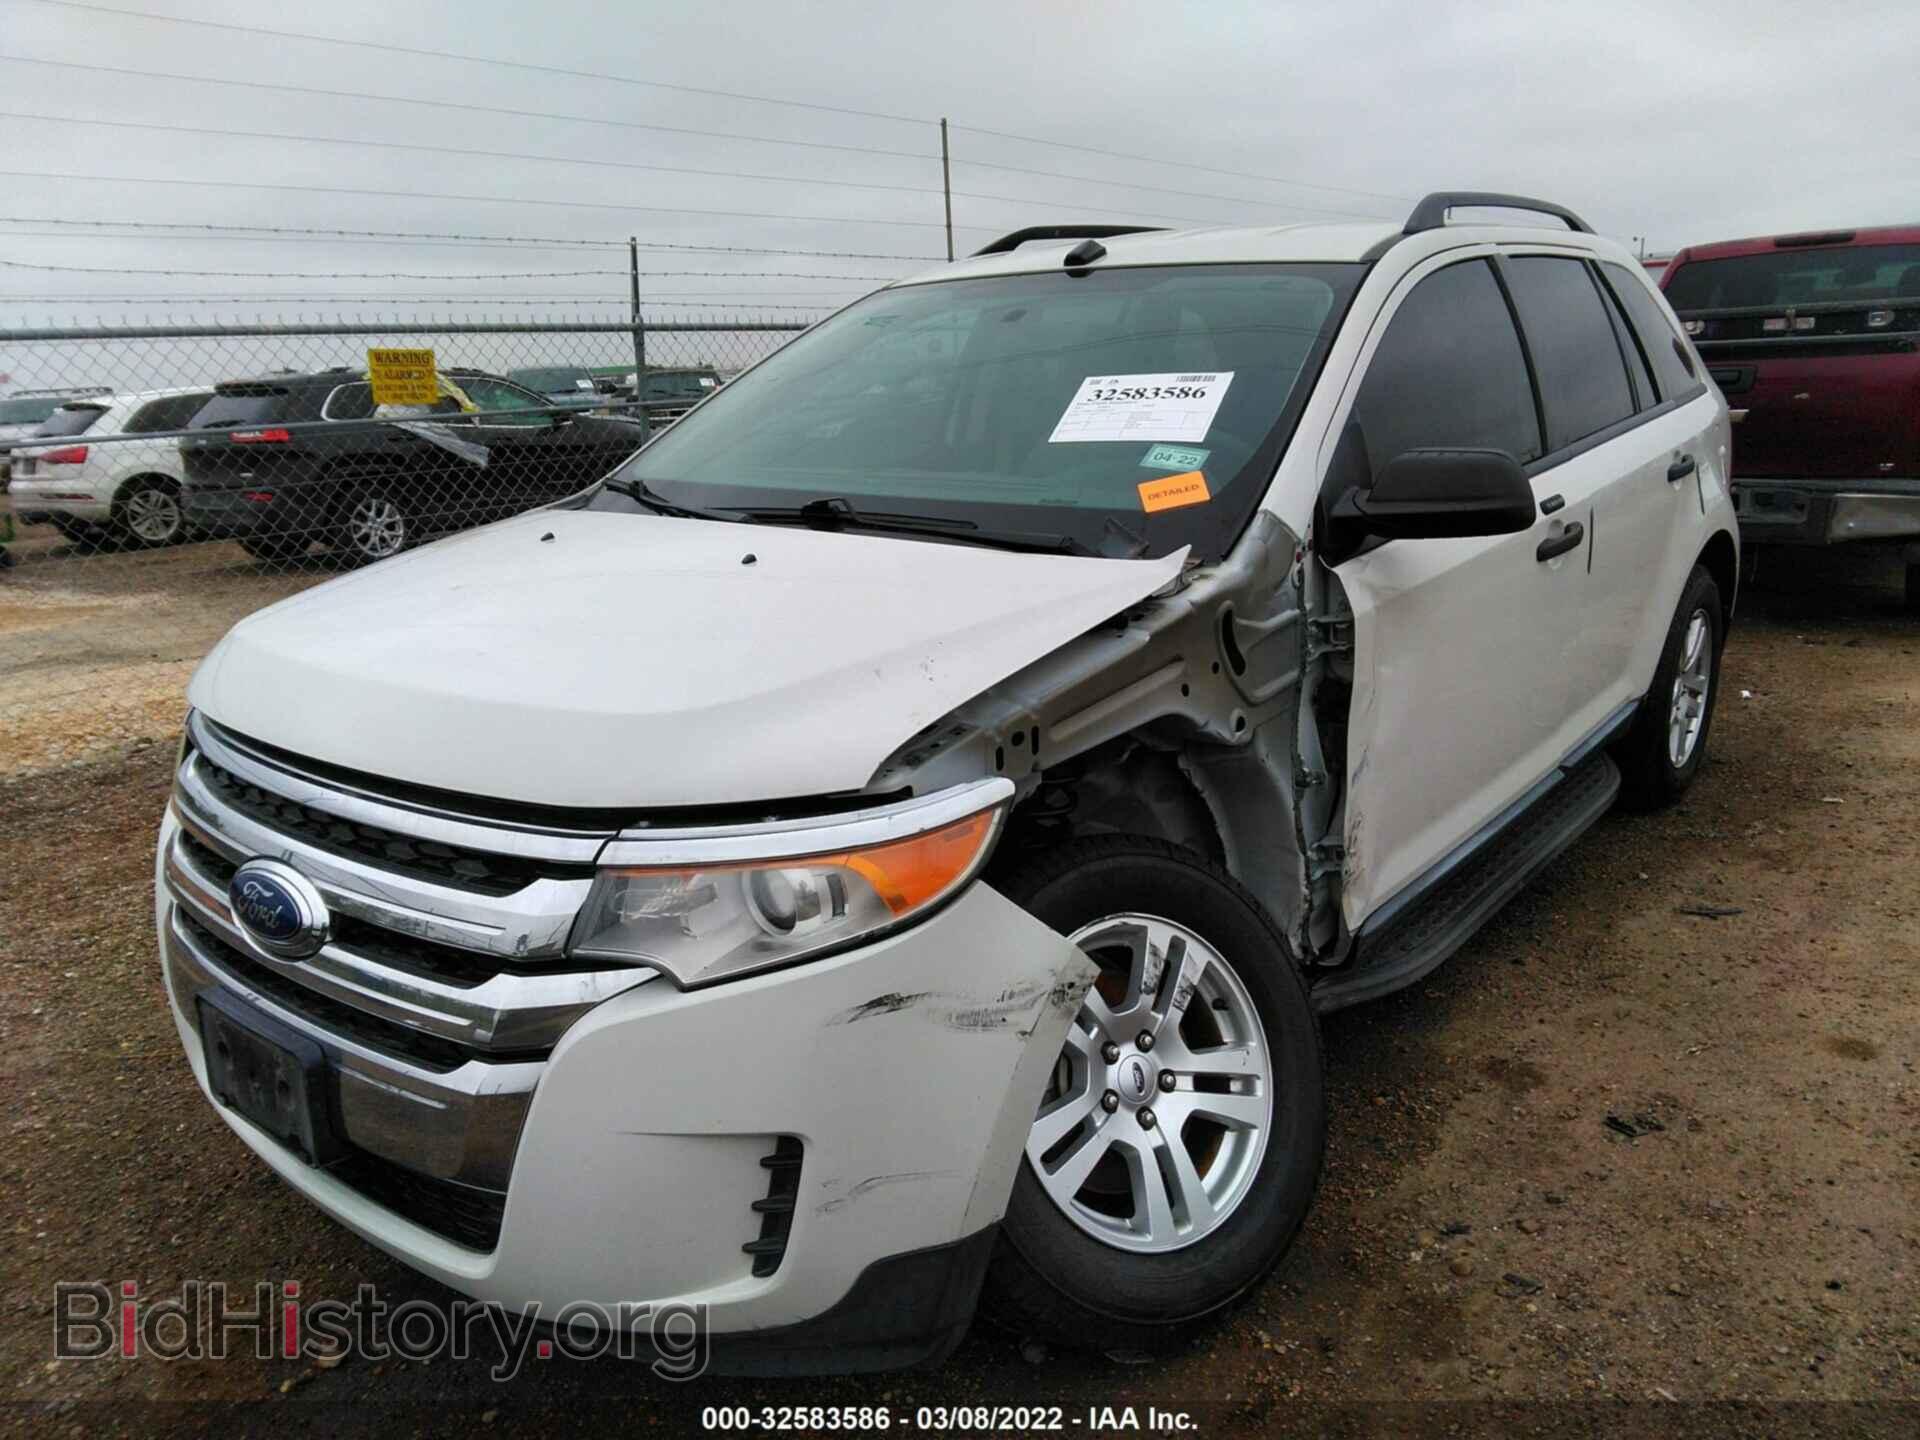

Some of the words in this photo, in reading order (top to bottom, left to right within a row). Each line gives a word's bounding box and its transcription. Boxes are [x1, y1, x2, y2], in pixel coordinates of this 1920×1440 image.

[374, 351, 430, 364] WARNING
[1088, 386, 1208, 402] 32583586
[1147, 483, 1200, 501] DETAILED
[240, 880, 284, 929] Ford
